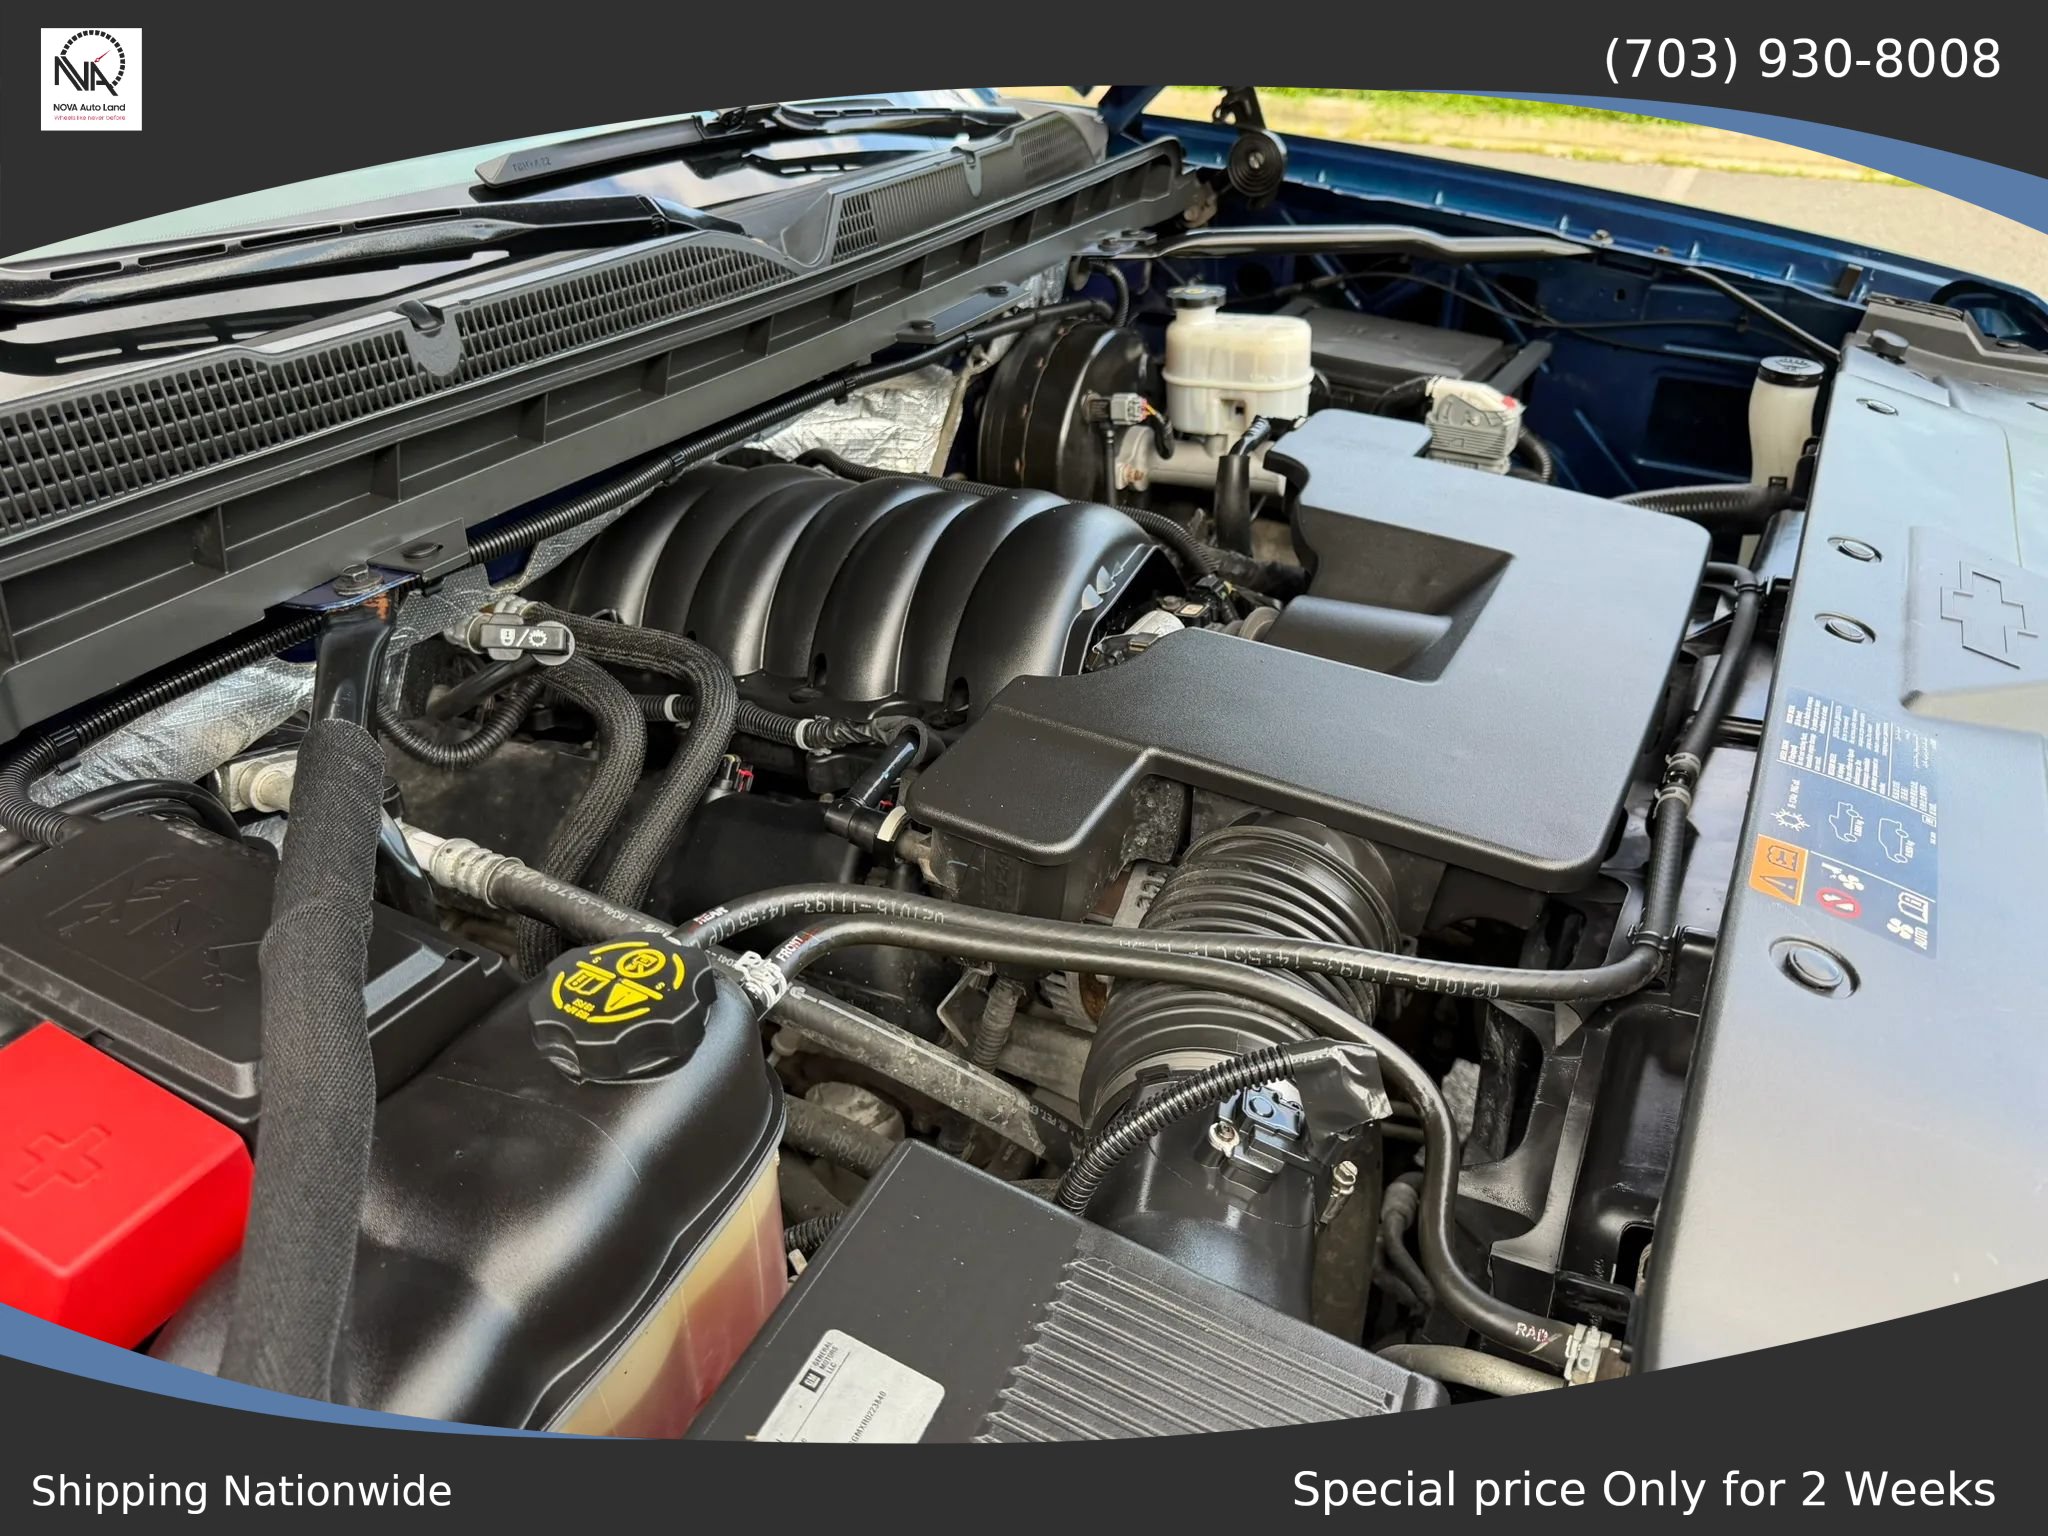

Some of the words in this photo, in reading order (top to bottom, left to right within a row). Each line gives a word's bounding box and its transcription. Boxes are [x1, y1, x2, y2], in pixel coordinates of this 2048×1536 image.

[692, 906, 729, 926] REAR
[775, 934, 804, 963] FRONT
[1914, 926, 1929, 950] AUTO
[812, 1341, 834, 1368] GENERAL
[819, 1345, 839, 1371] MOTORS
[826, 1361, 838, 1375] LLC
